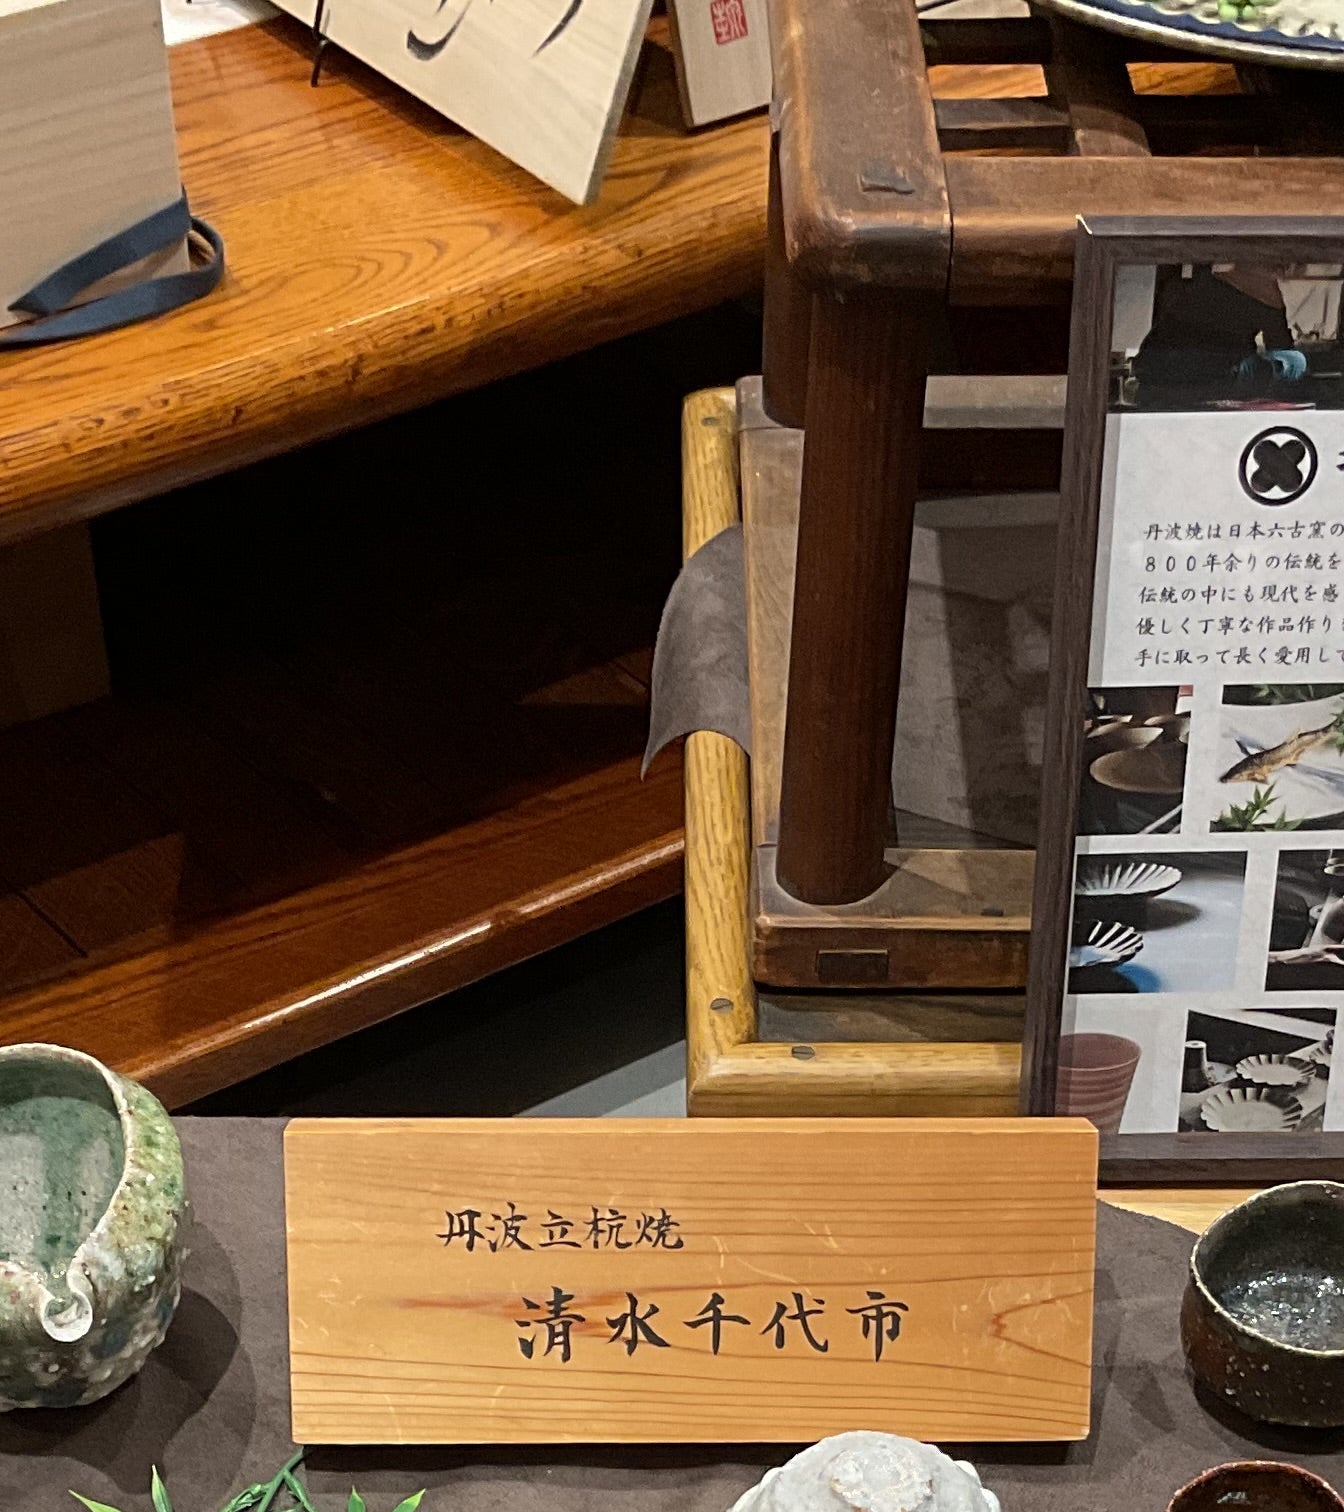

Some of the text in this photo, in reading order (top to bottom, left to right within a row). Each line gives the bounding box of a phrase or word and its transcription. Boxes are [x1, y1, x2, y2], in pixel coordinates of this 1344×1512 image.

[437, 1202, 685, 1253] 丹波立杭焼
[515, 1285, 912, 1364] 清水千代市
